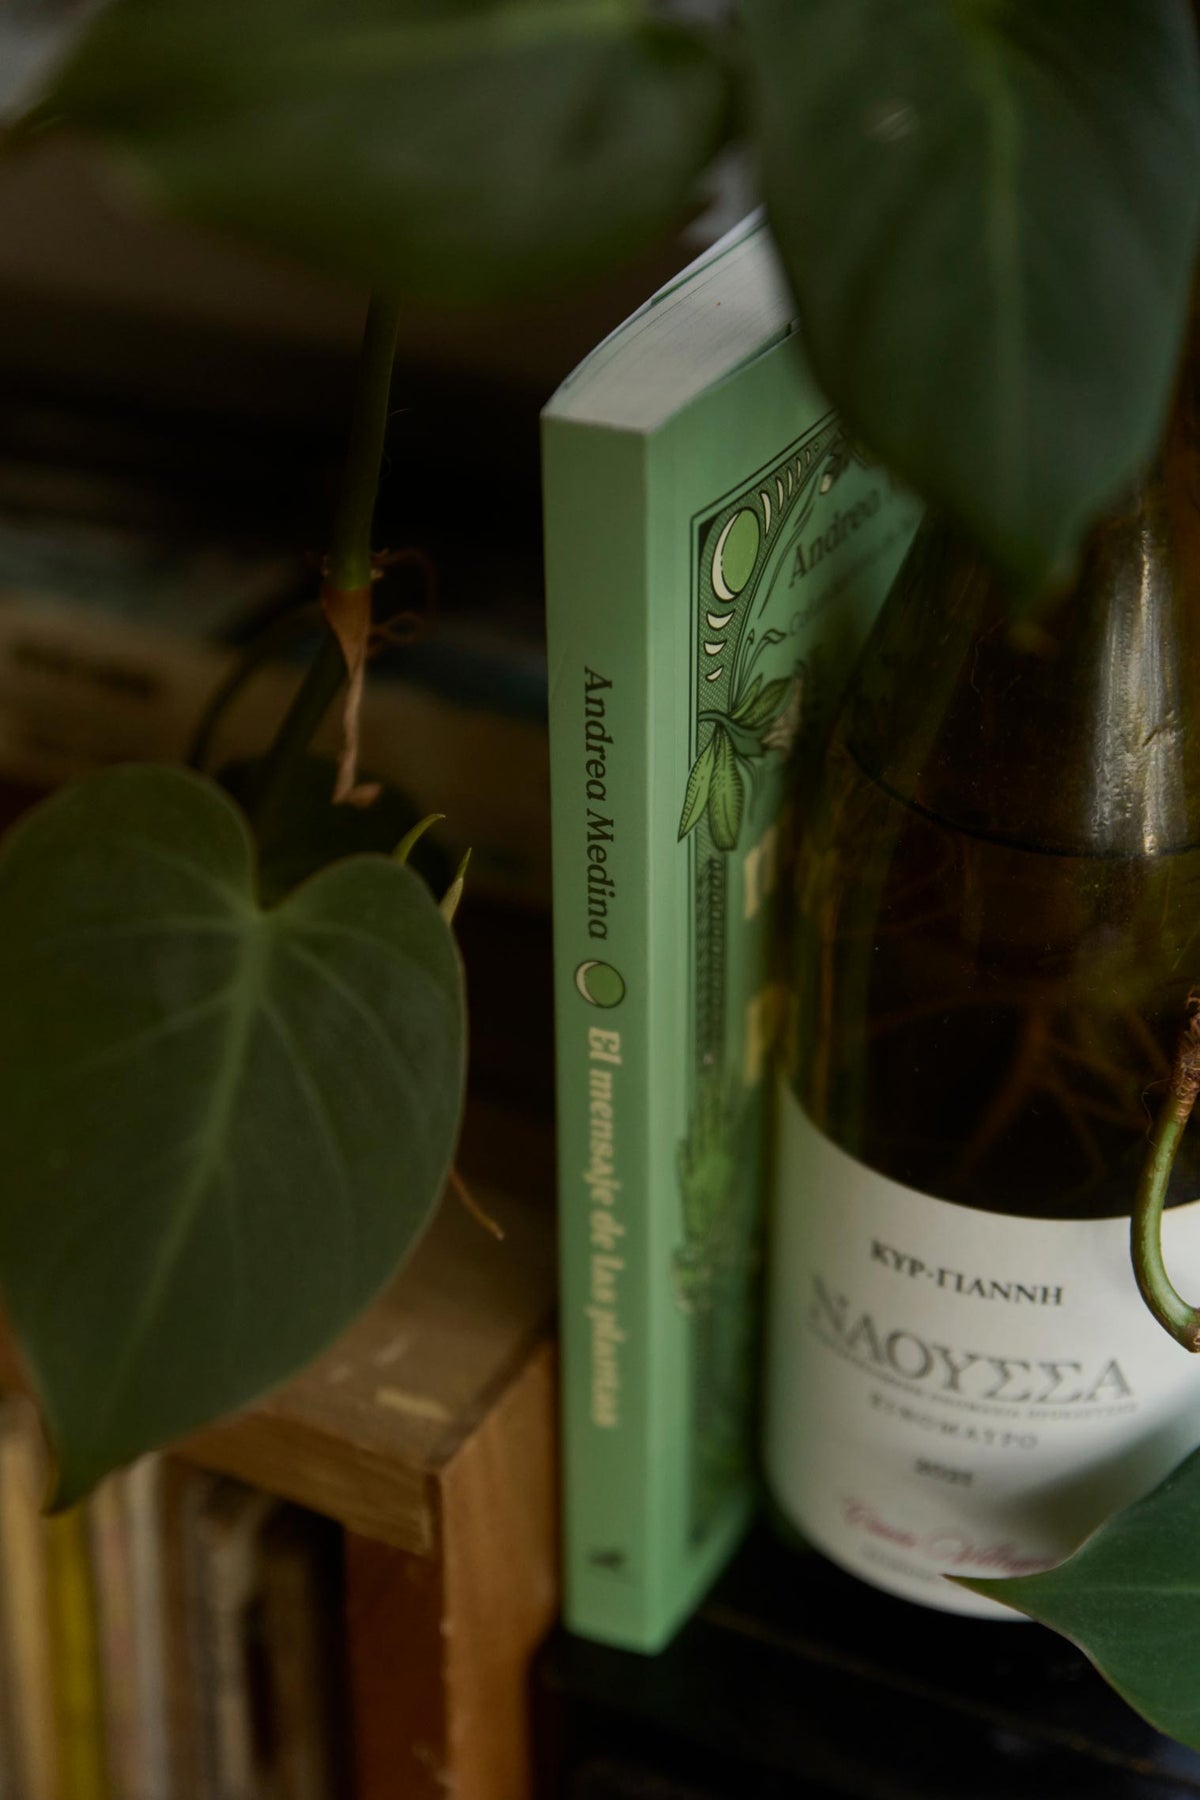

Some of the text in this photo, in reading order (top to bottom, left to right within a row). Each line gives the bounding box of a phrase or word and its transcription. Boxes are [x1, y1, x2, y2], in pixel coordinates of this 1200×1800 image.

[584, 665, 616, 940] Andrea Medina
[588, 1026, 622, 1066] El
[582, 1069, 623, 1206] mensaje
[589, 1209, 626, 1251] de
[810, 1273, 1134, 1403] ΝΑΟΥΣΣΑ
